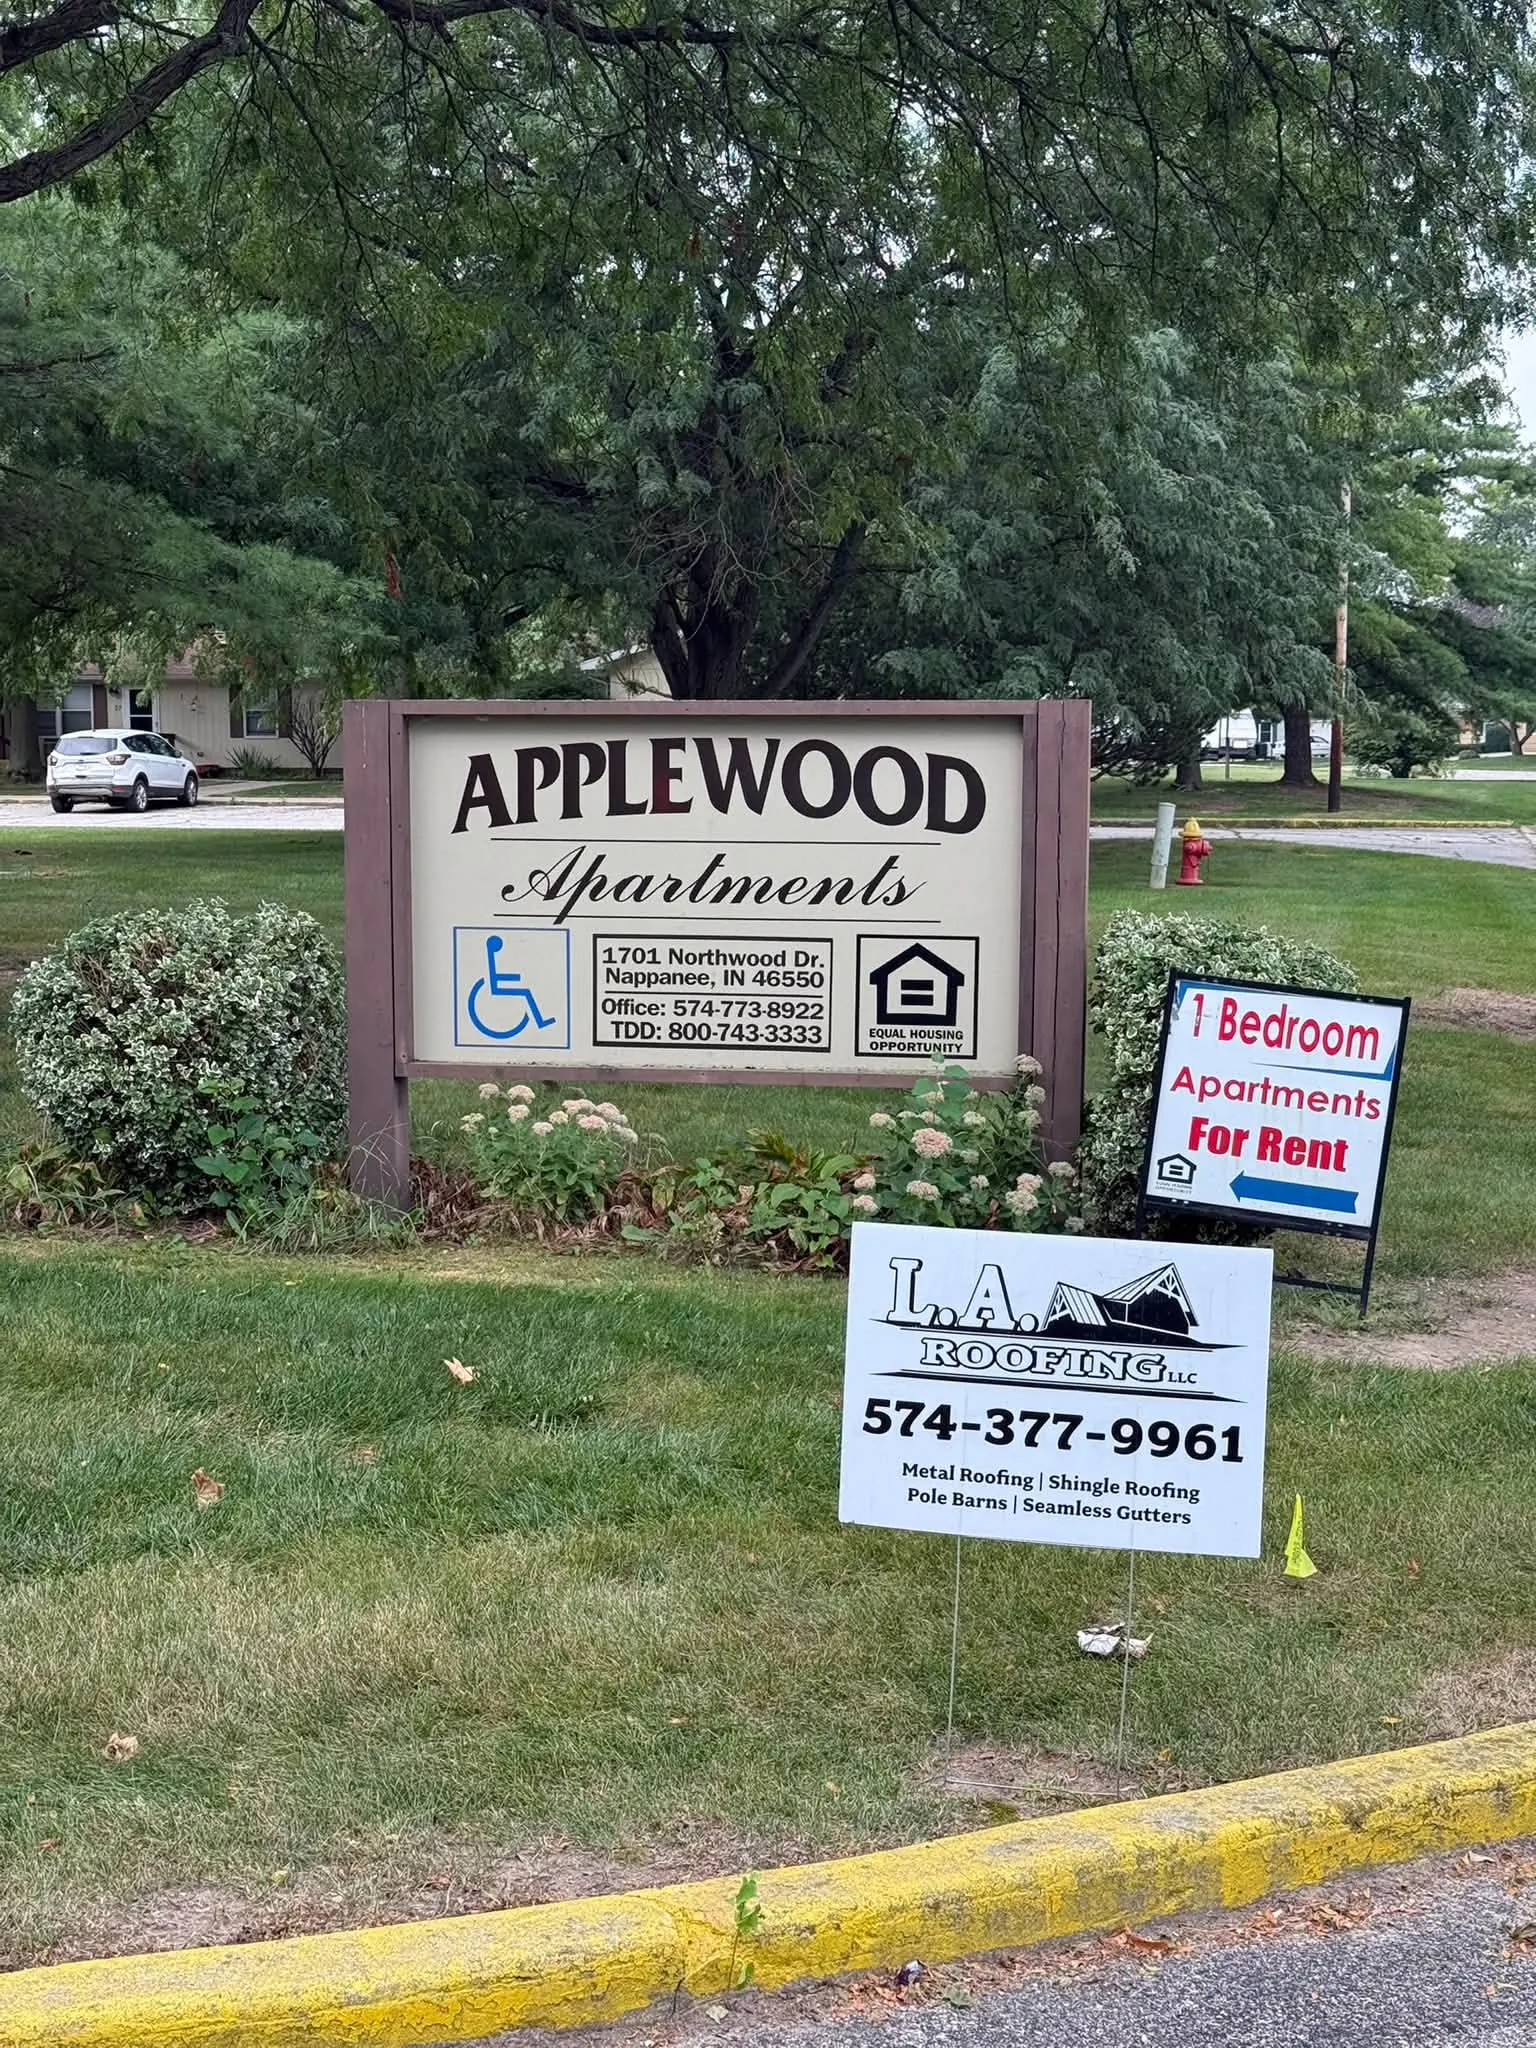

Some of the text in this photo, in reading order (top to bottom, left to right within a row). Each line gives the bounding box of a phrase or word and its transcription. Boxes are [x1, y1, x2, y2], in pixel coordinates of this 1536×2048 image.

[451, 737, 987, 834] APPLEWOOD
[500, 845, 928, 925] Apartments
[602, 947, 825, 968] 1701 Northwood Dr.
[605, 968, 825, 989] Nappanee, IN 46550
[601, 998, 824, 1020] Office: 574-773-8922
[1192, 993, 1379, 1061] 1 Bedroom
[611, 1021, 823, 1044] TDD: 800-743-3333
[869, 1028, 964, 1040] EQUAL HOUSING
[869, 1041, 963, 1053] OPPORTUNITY
[1170, 1066, 1381, 1120] Apartments
[1188, 1116, 1349, 1173] For Rent
[886, 1256, 1040, 1333] L.A.
[919, 1337, 1197, 1384] ROOFING LLC
[862, 1397, 1245, 1463] 574-377-9961
[902, 1462, 955, 1482] Metal
[959, 1468, 1034, 1491] Roofing
[1048, 1475, 1120, 1497] Shingle
[1125, 1481, 1201, 1504] Roofing
[907, 1487, 948, 1505] Pole
[951, 1492, 1008, 1510] Barns
[1022, 1498, 1112, 1518] Seamless
[1116, 1506, 1192, 1525] Gutters
